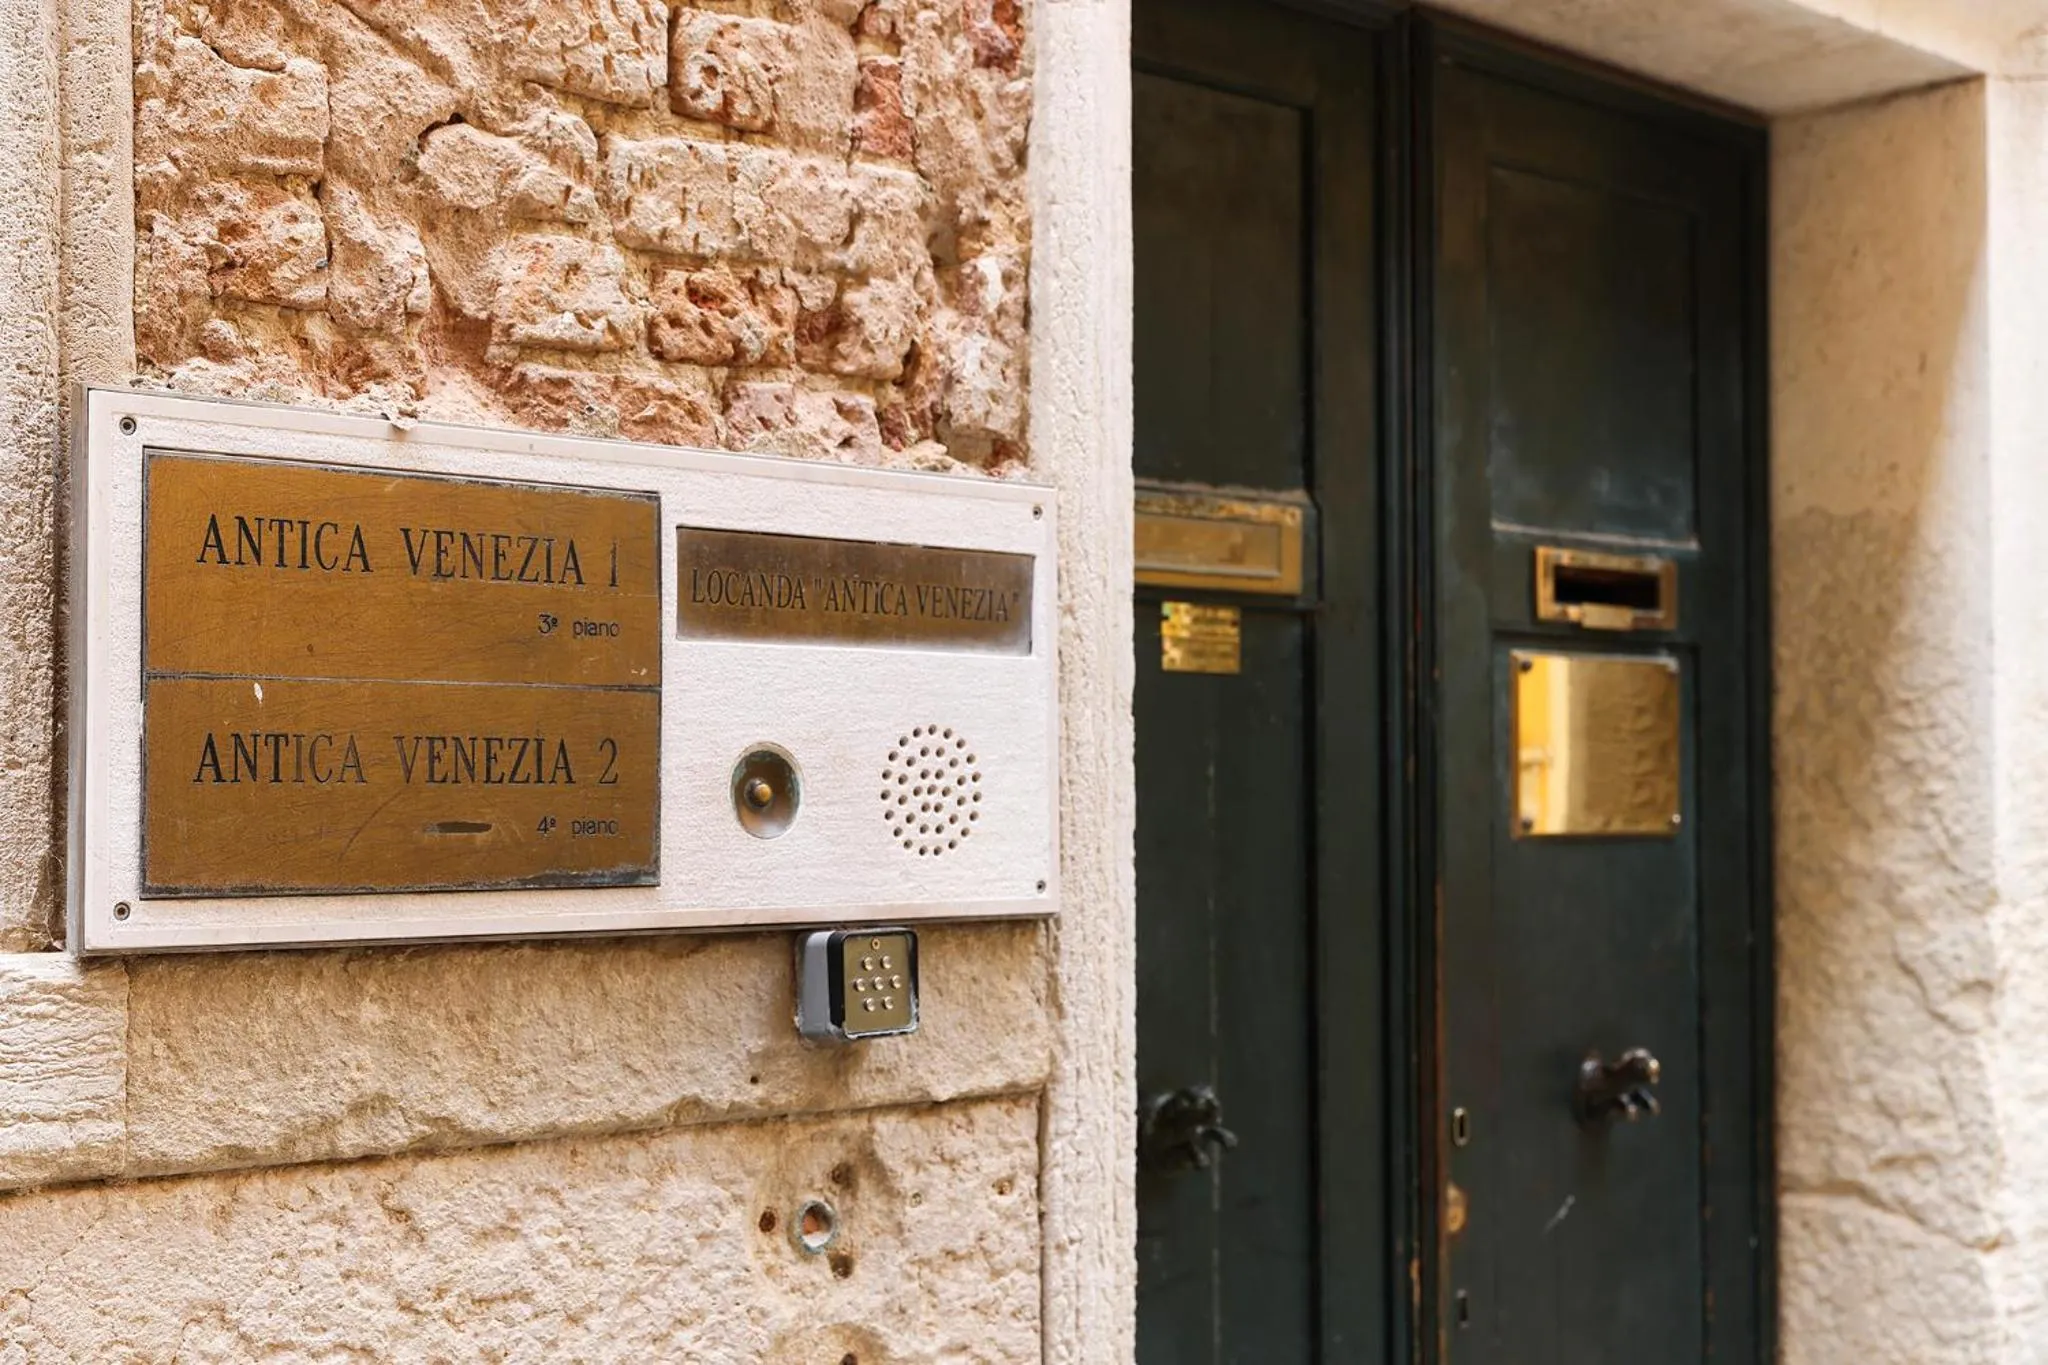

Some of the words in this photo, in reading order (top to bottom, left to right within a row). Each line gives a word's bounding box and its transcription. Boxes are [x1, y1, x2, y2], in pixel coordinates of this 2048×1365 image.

[196, 513, 373, 573] ANTICA
[400, 527, 586, 585] VENEZIA
[692, 569, 807, 610] LOCANDA
[814, 577, 909, 616] "ANTICA
[572, 618, 621, 638] piano
[193, 733, 368, 784] ANTICA
[598, 738, 619, 785] 2
[571, 817, 620, 836] piano
